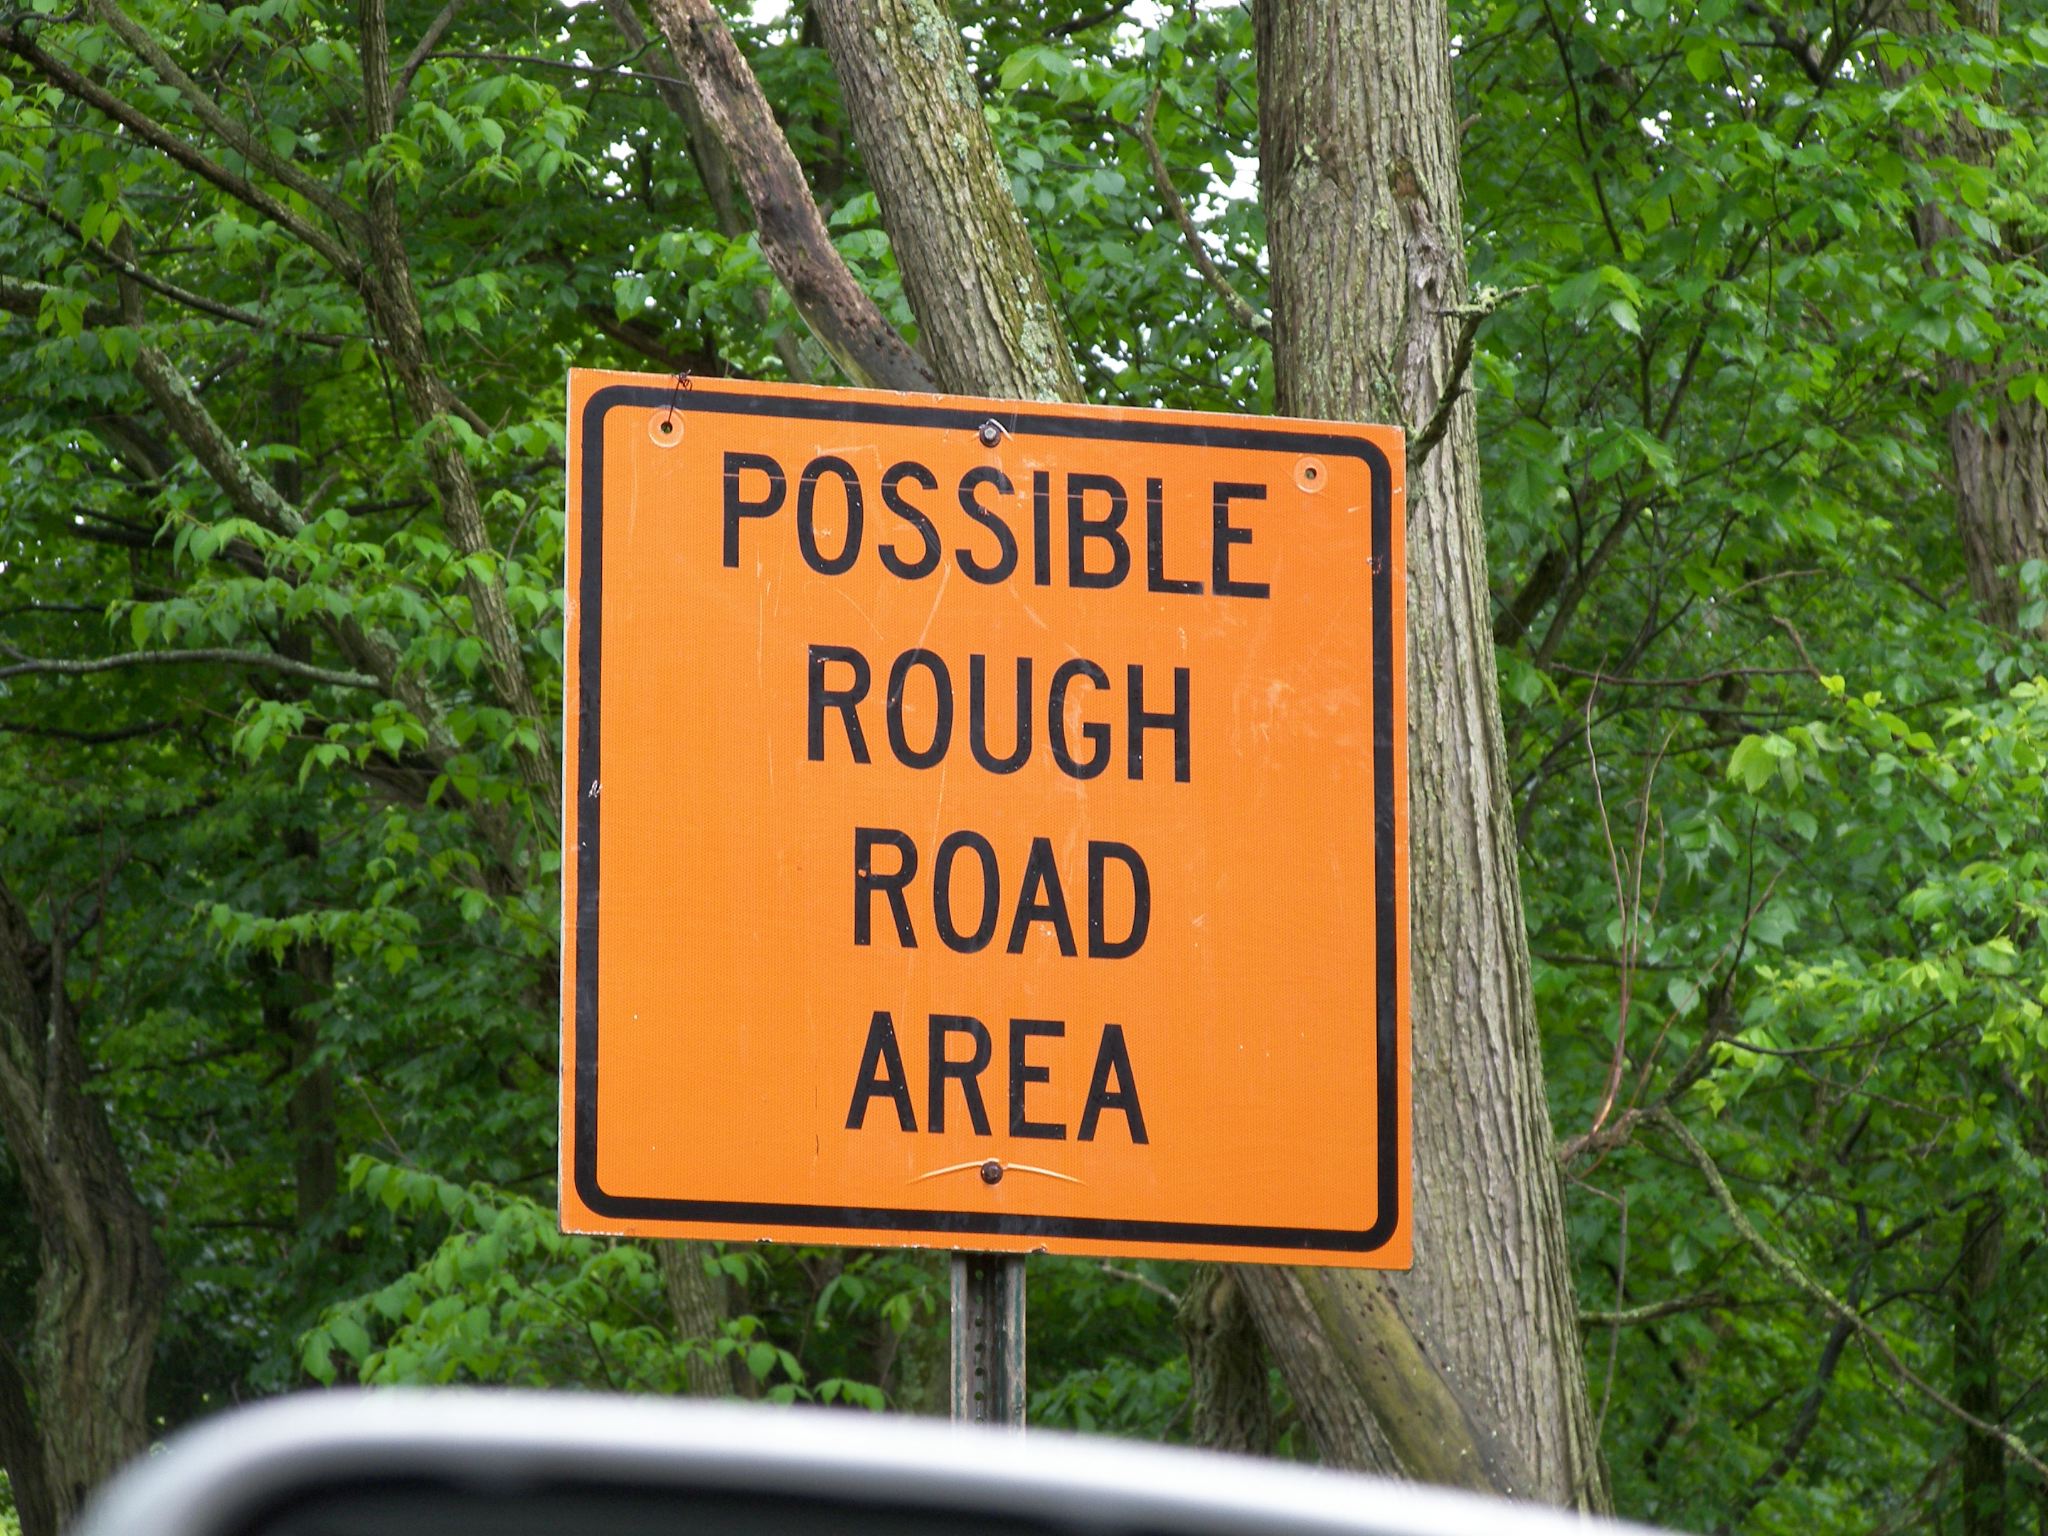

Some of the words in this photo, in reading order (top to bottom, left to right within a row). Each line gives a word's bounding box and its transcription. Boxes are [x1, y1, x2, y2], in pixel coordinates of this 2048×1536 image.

[723, 451, 1270, 599] POSSIBLE
[807, 644, 1191, 783] ROUGH
[854, 827, 1151, 959] ROAD
[845, 1011, 1149, 1145] AREA
